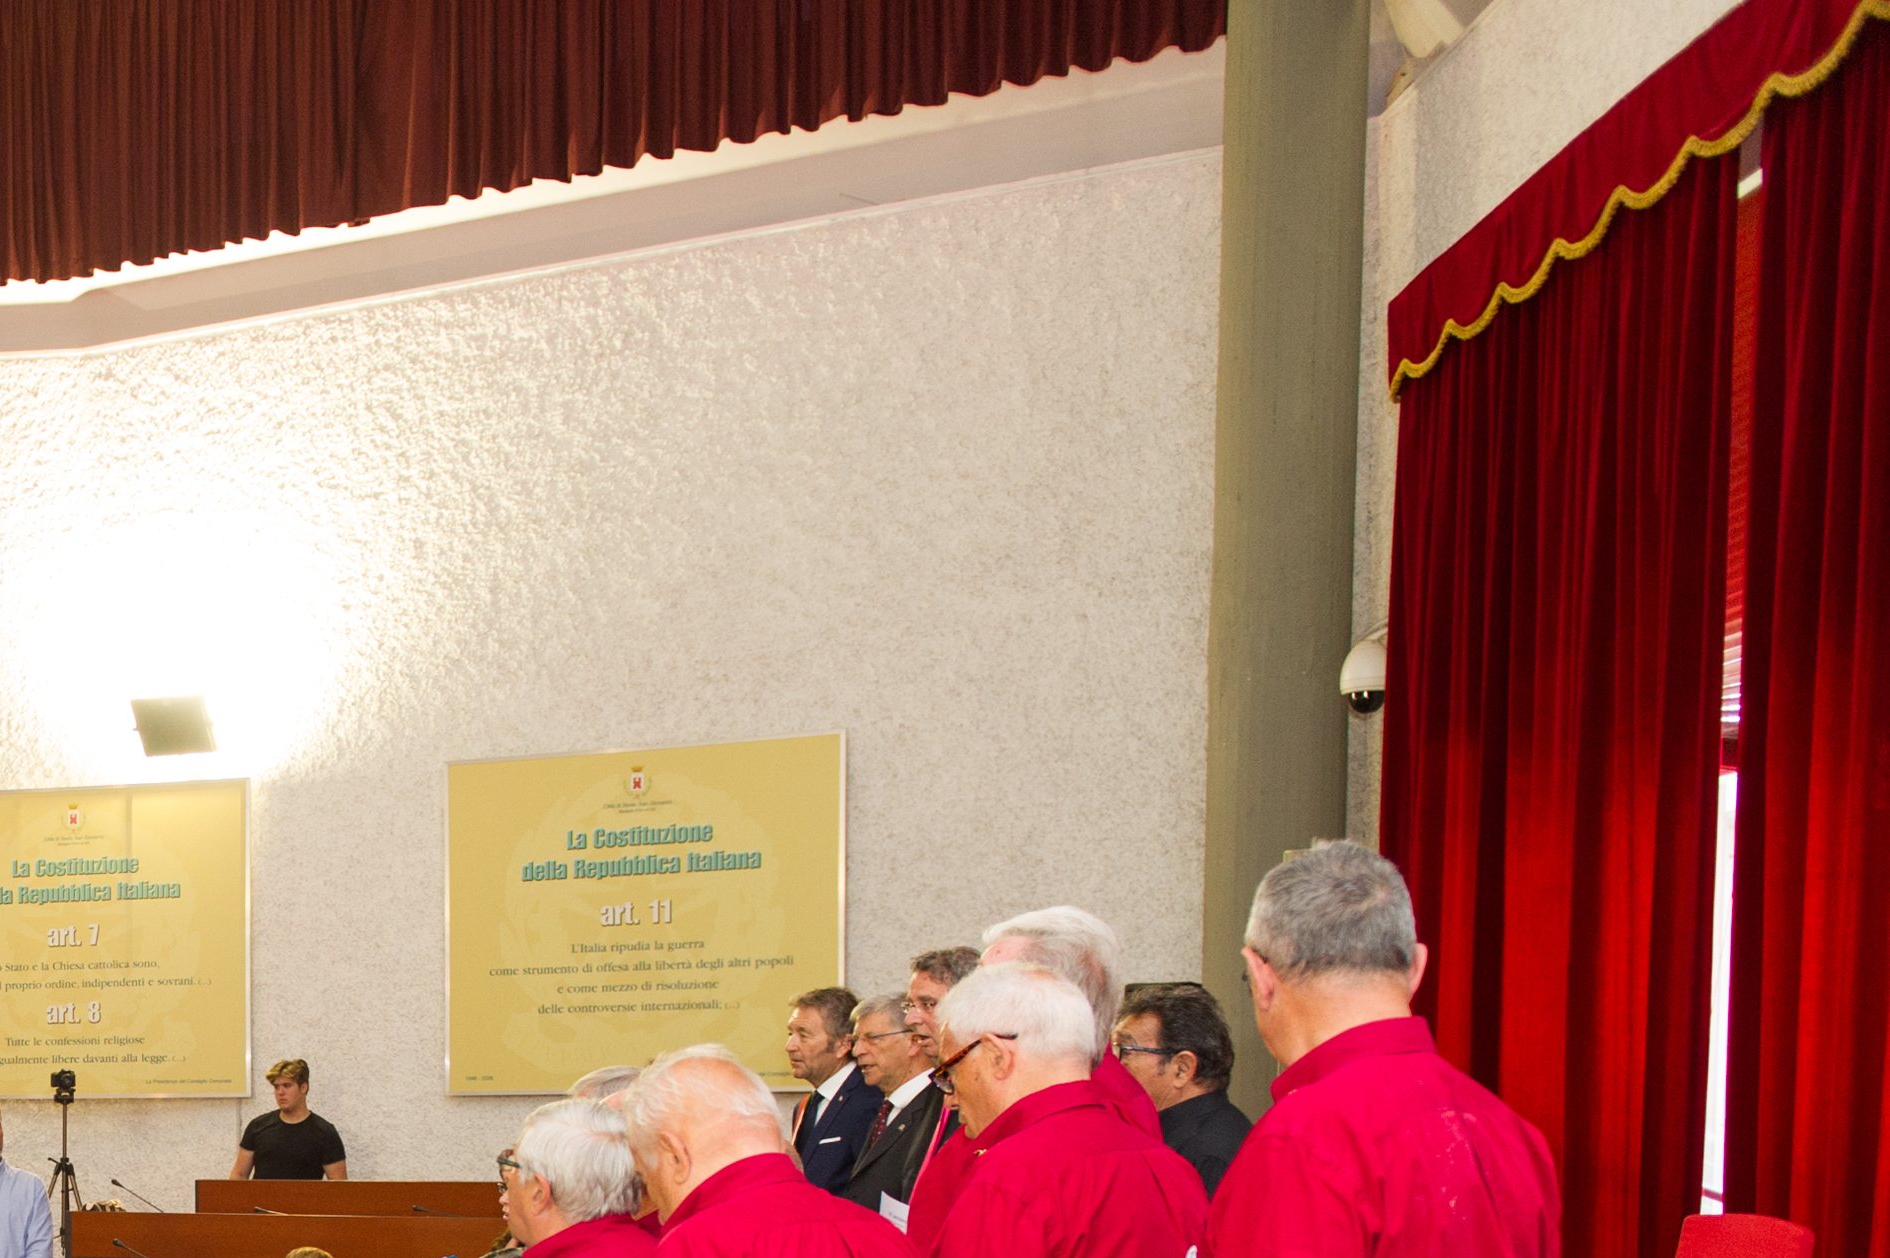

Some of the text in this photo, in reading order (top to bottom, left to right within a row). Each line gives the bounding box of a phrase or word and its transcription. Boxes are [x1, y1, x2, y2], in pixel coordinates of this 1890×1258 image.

[567, 824, 713, 850] La Costituzione
[12, 857, 139, 878] La Costituzione
[522, 851, 762, 882] della Repubblica Italiana
[18, 884, 111, 905] Repubblica
[116, 882, 181, 900] Italiana
[602, 899, 672, 927] art. 11
[47, 924, 100, 948] art. 7
[572, 941, 705, 954] L'Italia ripudia la guerra
[52, 962, 87, 970] Chiesa
[88, 960, 130, 969] cattolica
[523, 966, 579, 974] strumento
[582, 964, 593, 972] di
[596, 963, 630, 972] offesa
[632, 961, 653, 971] alla
[655, 960, 692, 970] libertà
[696, 958, 725, 970] degli
[728, 958, 751, 967] altri
[755, 955, 794, 969] popoli
[6, 981, 41, 992] proprio
[46, 980, 79, 989] ordine,
[83, 978, 144, 989] indipendenti
[601, 984, 638, 992] mezzo
[641, 981, 652, 990] di
[656, 981, 719, 990] risoluzione
[47, 1001, 101, 1025] art. 8
[537, 1004, 564, 1014] delle
[568, 1005, 638, 1013] controversie
[5, 1038, 30, 1046] Tutte
[44, 1037, 100, 1045] confessioni
[104, 1036, 145, 1046] religiose
[52, 1055, 79, 1063] libere
[83, 1055, 118, 1063] davanti
[121, 1054, 138, 1062] alla
